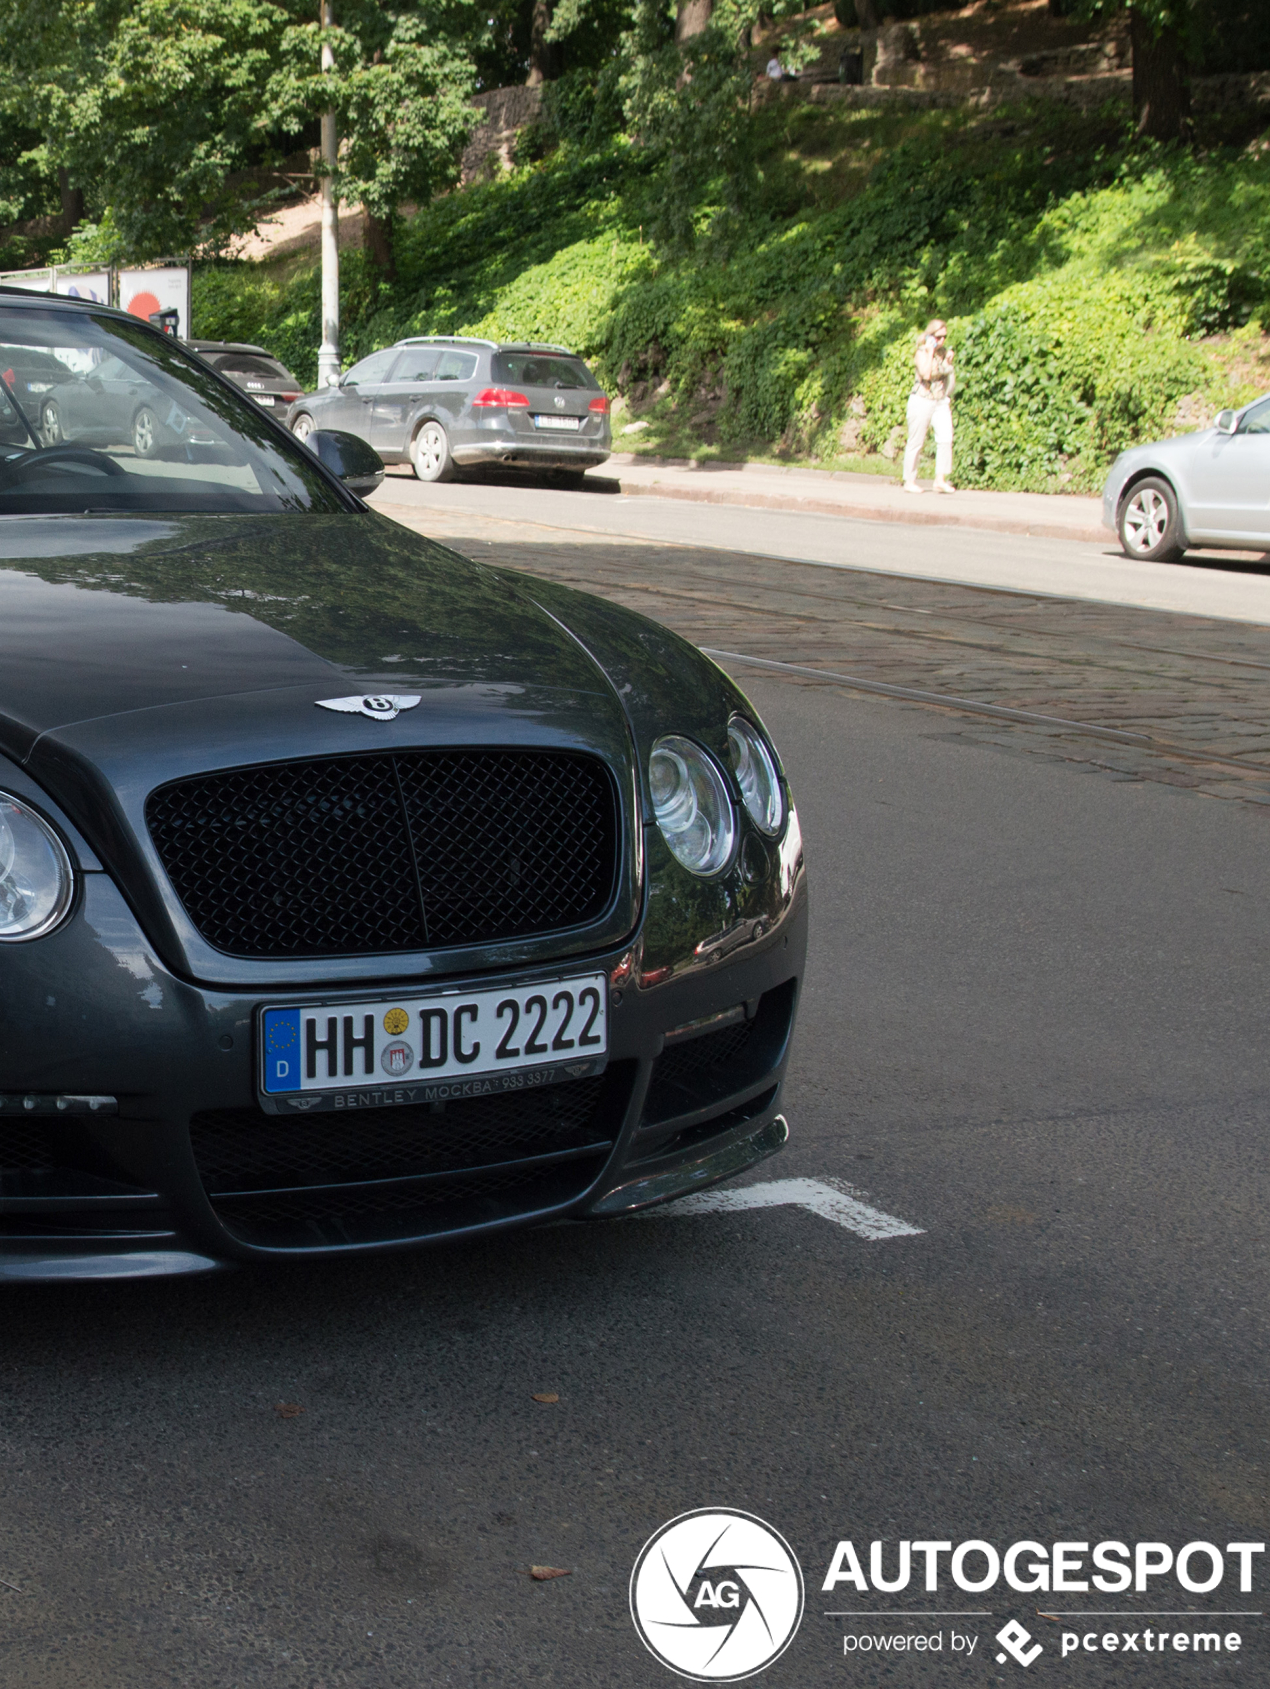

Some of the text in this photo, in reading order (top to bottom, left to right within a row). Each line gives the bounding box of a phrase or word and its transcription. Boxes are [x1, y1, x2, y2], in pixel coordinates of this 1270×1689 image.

[305, 1014, 375, 1079] HH
[418, 1003, 481, 1069] DC
[495, 986, 601, 1060] 2222
[276, 1060, 290, 1078] D
[334, 1089, 418, 1108] BENTLEY
[502, 1073, 524, 1089] 933
[527, 1069, 556, 1086] 3377
